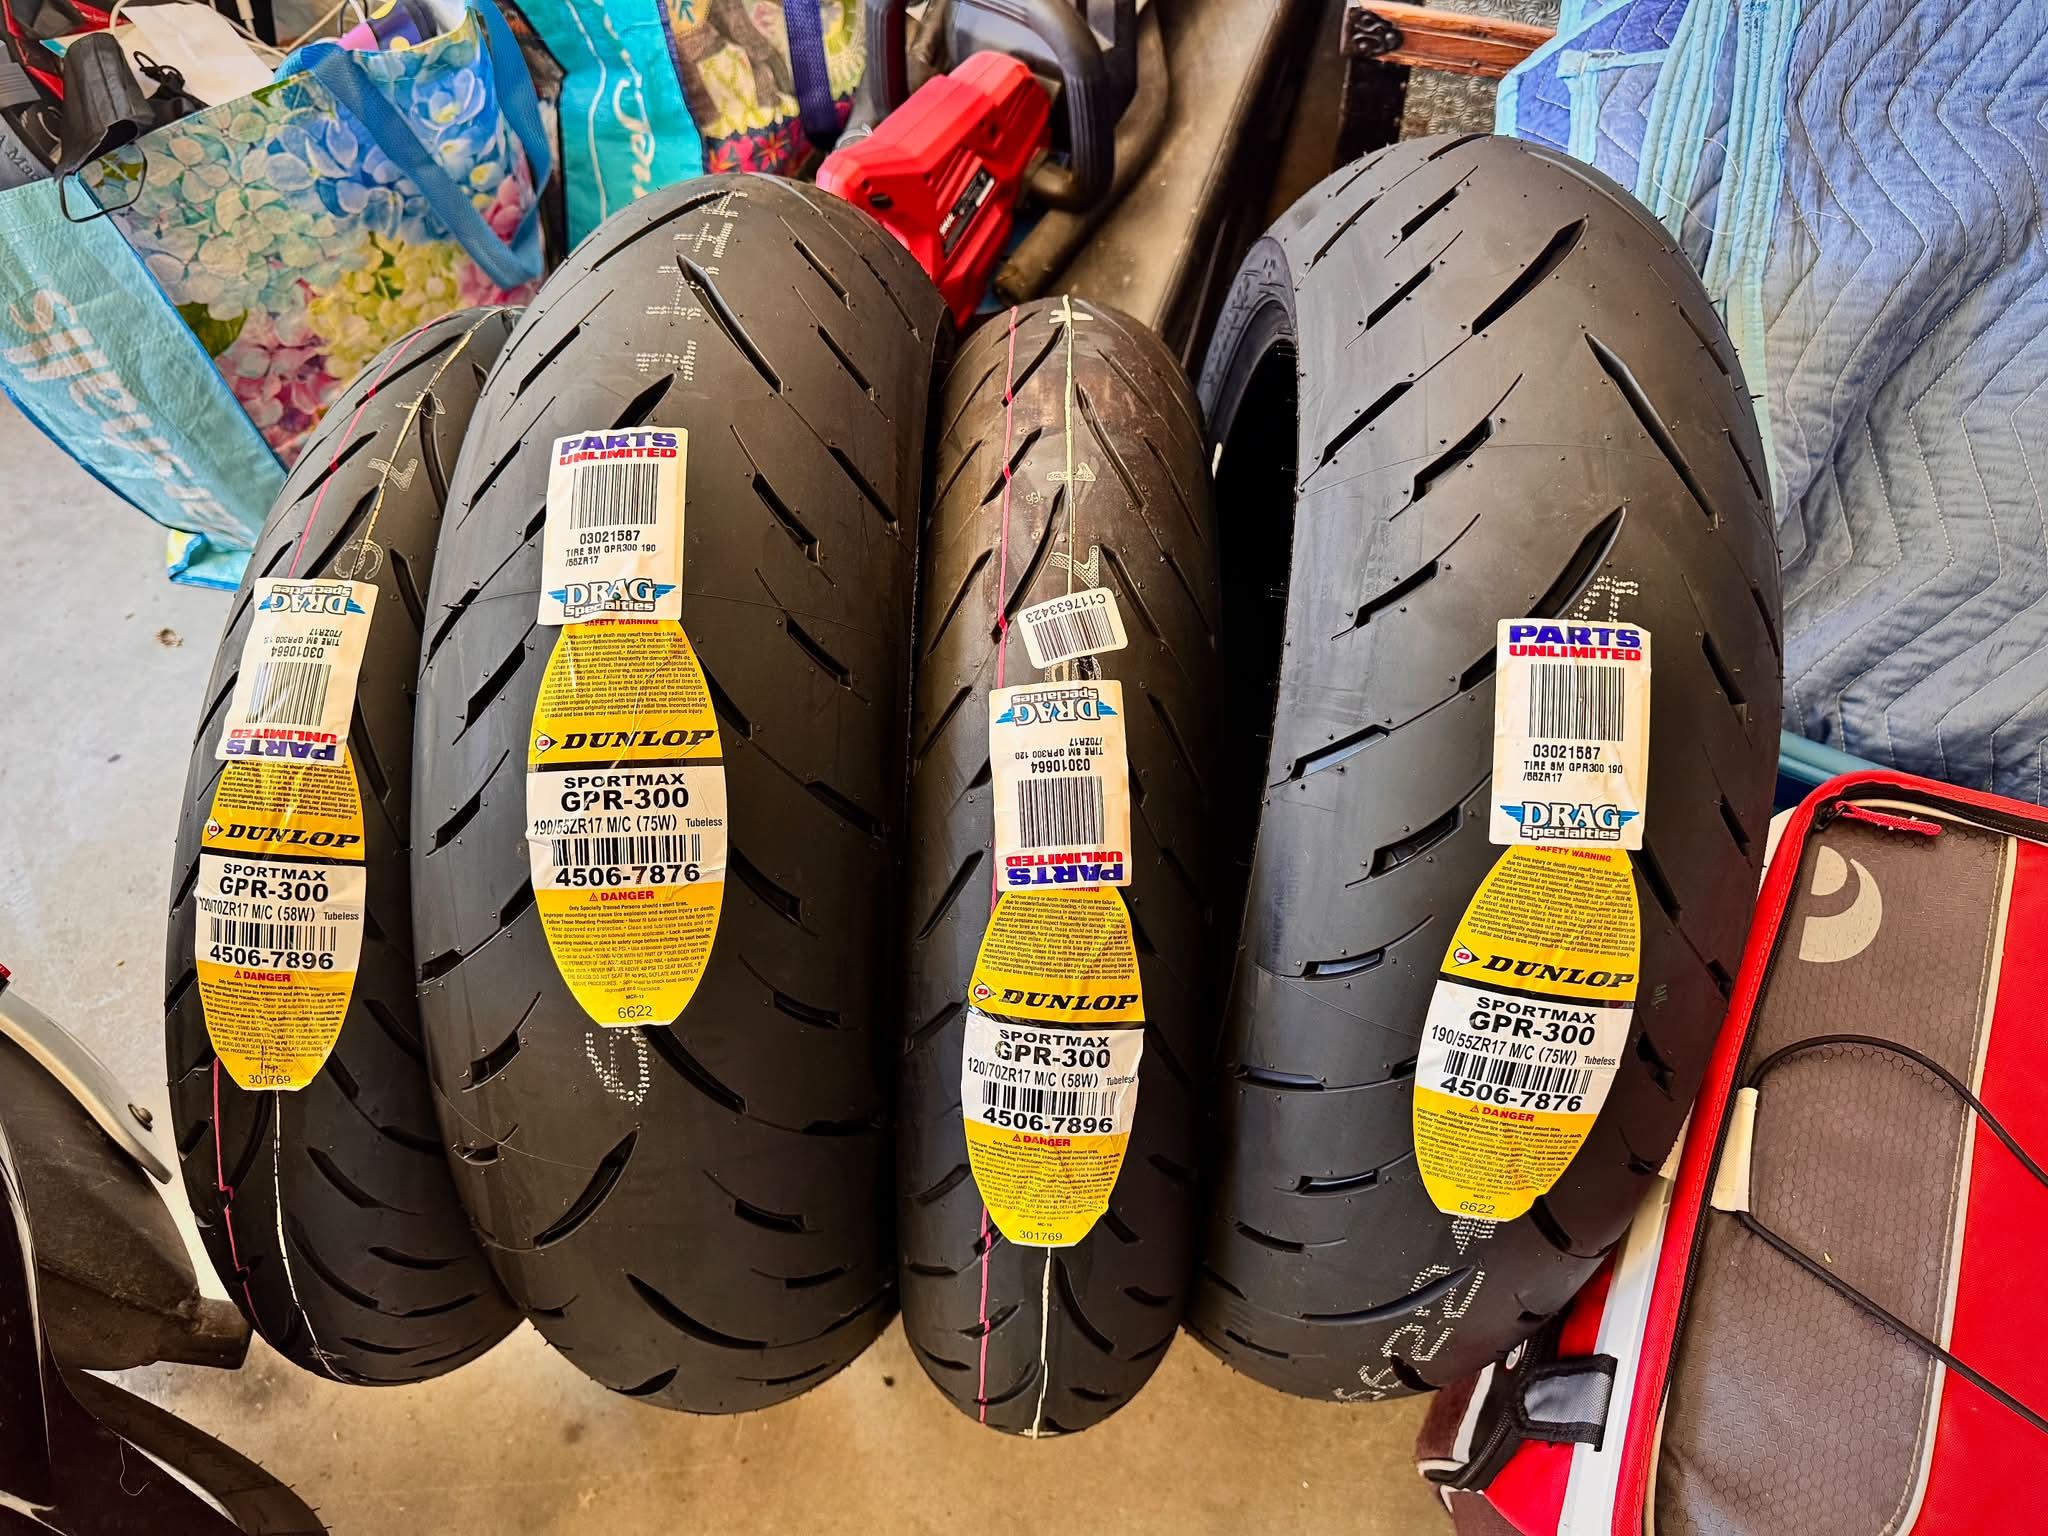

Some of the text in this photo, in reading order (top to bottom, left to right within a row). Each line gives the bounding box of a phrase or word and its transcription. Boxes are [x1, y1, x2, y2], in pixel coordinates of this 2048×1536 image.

[560, 432, 678, 456] PARTS
[560, 448, 676, 465] UNLIMITED
[580, 531, 640, 544] 03021587
[566, 547, 584, 557] TIRE
[605, 544, 637, 554] GPR300
[642, 544, 656, 552] 190
[566, 556, 599, 567] /55ZR17
[272, 585, 352, 597] Specialties
[565, 578, 655, 604] DRAG
[270, 592, 350, 615] DRAG
[564, 599, 654, 618] Specialties
[1026, 593, 1106, 623] C117633423
[309, 628, 343, 638] /70ZR17
[321, 637, 340, 646] TIRE
[1509, 625, 1642, 650] PARTS
[271, 646, 324, 659] 03010664
[1510, 645, 1641, 661] UNLIMITED
[1011, 688, 1098, 705] Specialties
[1012, 700, 1099, 726] DRAG
[231, 729, 337, 744] UNLIMITED
[560, 730, 713, 750] DUNLOP
[1070, 738, 1102, 746] /70ZR17
[226, 738, 336, 761] PARTS
[1533, 744, 1600, 760] 03021587
[1031, 758, 1090, 773] 03010664
[1524, 761, 1546, 770] TIRE
[1608, 765, 1622, 774] 190
[564, 773, 684, 788] SPORTMAX
[1523, 772, 1562, 783] /55ZR17
[561, 788, 689, 811] GPR-300
[1521, 801, 1621, 828] DRAG
[534, 815, 722, 835] 190/55ZR17 M/C (75W) Tubeless
[1520, 827, 1620, 840] Specialties
[226, 823, 361, 848] DUNLOP
[1006, 851, 1122, 867] UNLIMITED
[1535, 846, 1612, 862] SAFETY WARNING
[223, 863, 326, 881] SPORTMAX
[556, 864, 700, 886] 4506-7876
[1006, 863, 1123, 885] PARTS
[1512, 868, 1538, 876] accessory
[1539, 872, 1567, 881] restrictions
[219, 877, 328, 902] GPR-300
[601, 891, 654, 901] DANGER
[200, 897, 359, 922] 120/70ZR17 M/C (58W) Tubeless
[210, 945, 334, 969] 4506-7896
[243, 972, 291, 982] DANGER
[1482, 955, 1634, 988] DUNLOP
[999, 989, 1138, 1011] DUNLOP
[618, 1005, 652, 1019] 6622
[1476, 997, 1597, 1024] SPORTMAX
[1469, 1011, 1595, 1046] GPR-300
[1000, 1029, 1110, 1047] SPORTMAX
[1432, 1025, 1616, 1066] 190/55ZR17 M/C (75W) Tubeless
[995, 1041, 1110, 1068] GPR-300
[249, 1074, 291, 1086] 301769
[967, 1058, 1135, 1089] 120/70ZR17 M/C (58W) Tubeless
[1440, 1076, 1583, 1112] 4506-7876
[983, 1107, 1113, 1134] 4506-7896
[1482, 1108, 1535, 1122] DANGER
[1023, 1136, 1071, 1147] DANGER
[1460, 1202, 1495, 1214] 6622
[1019, 1230, 1063, 1241] 301769
